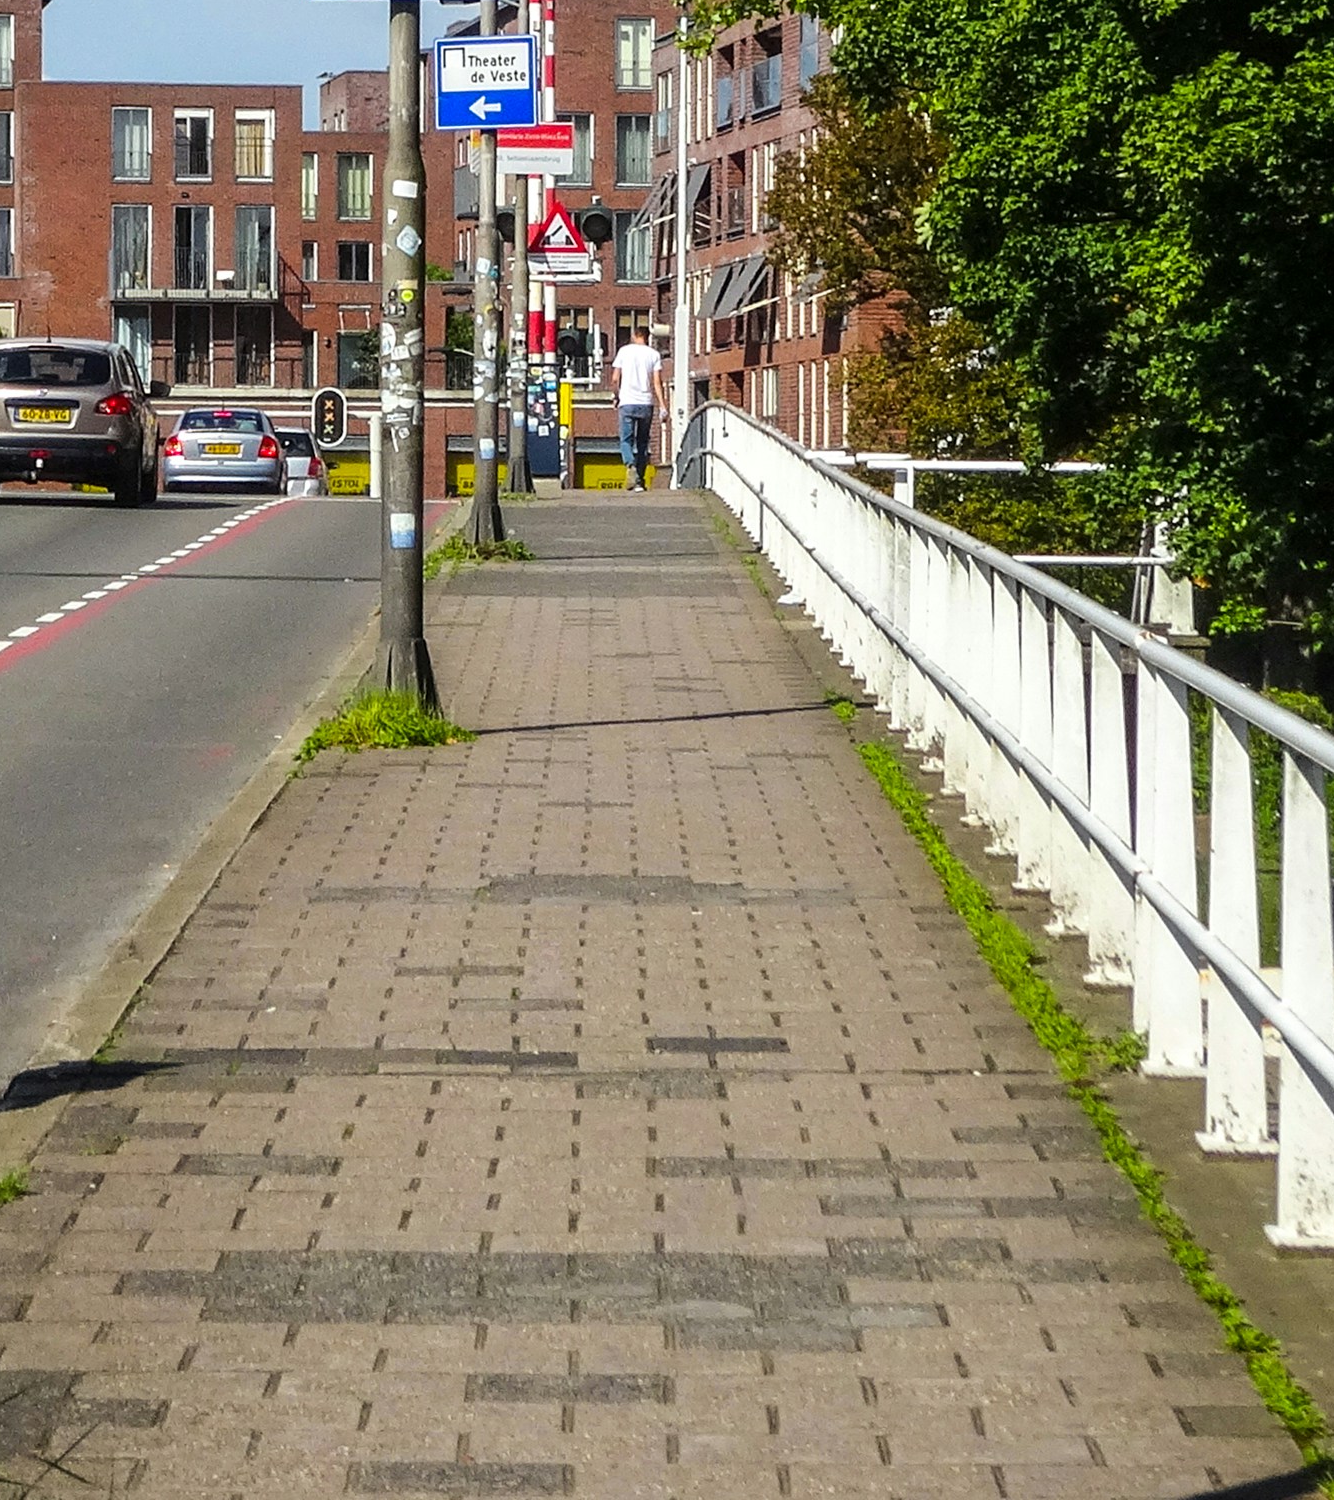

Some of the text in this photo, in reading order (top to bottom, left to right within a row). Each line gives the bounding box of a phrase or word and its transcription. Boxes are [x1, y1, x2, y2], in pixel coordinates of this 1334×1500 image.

[468, 55, 516, 67] Theater
[471, 70, 527, 83] de Veste
